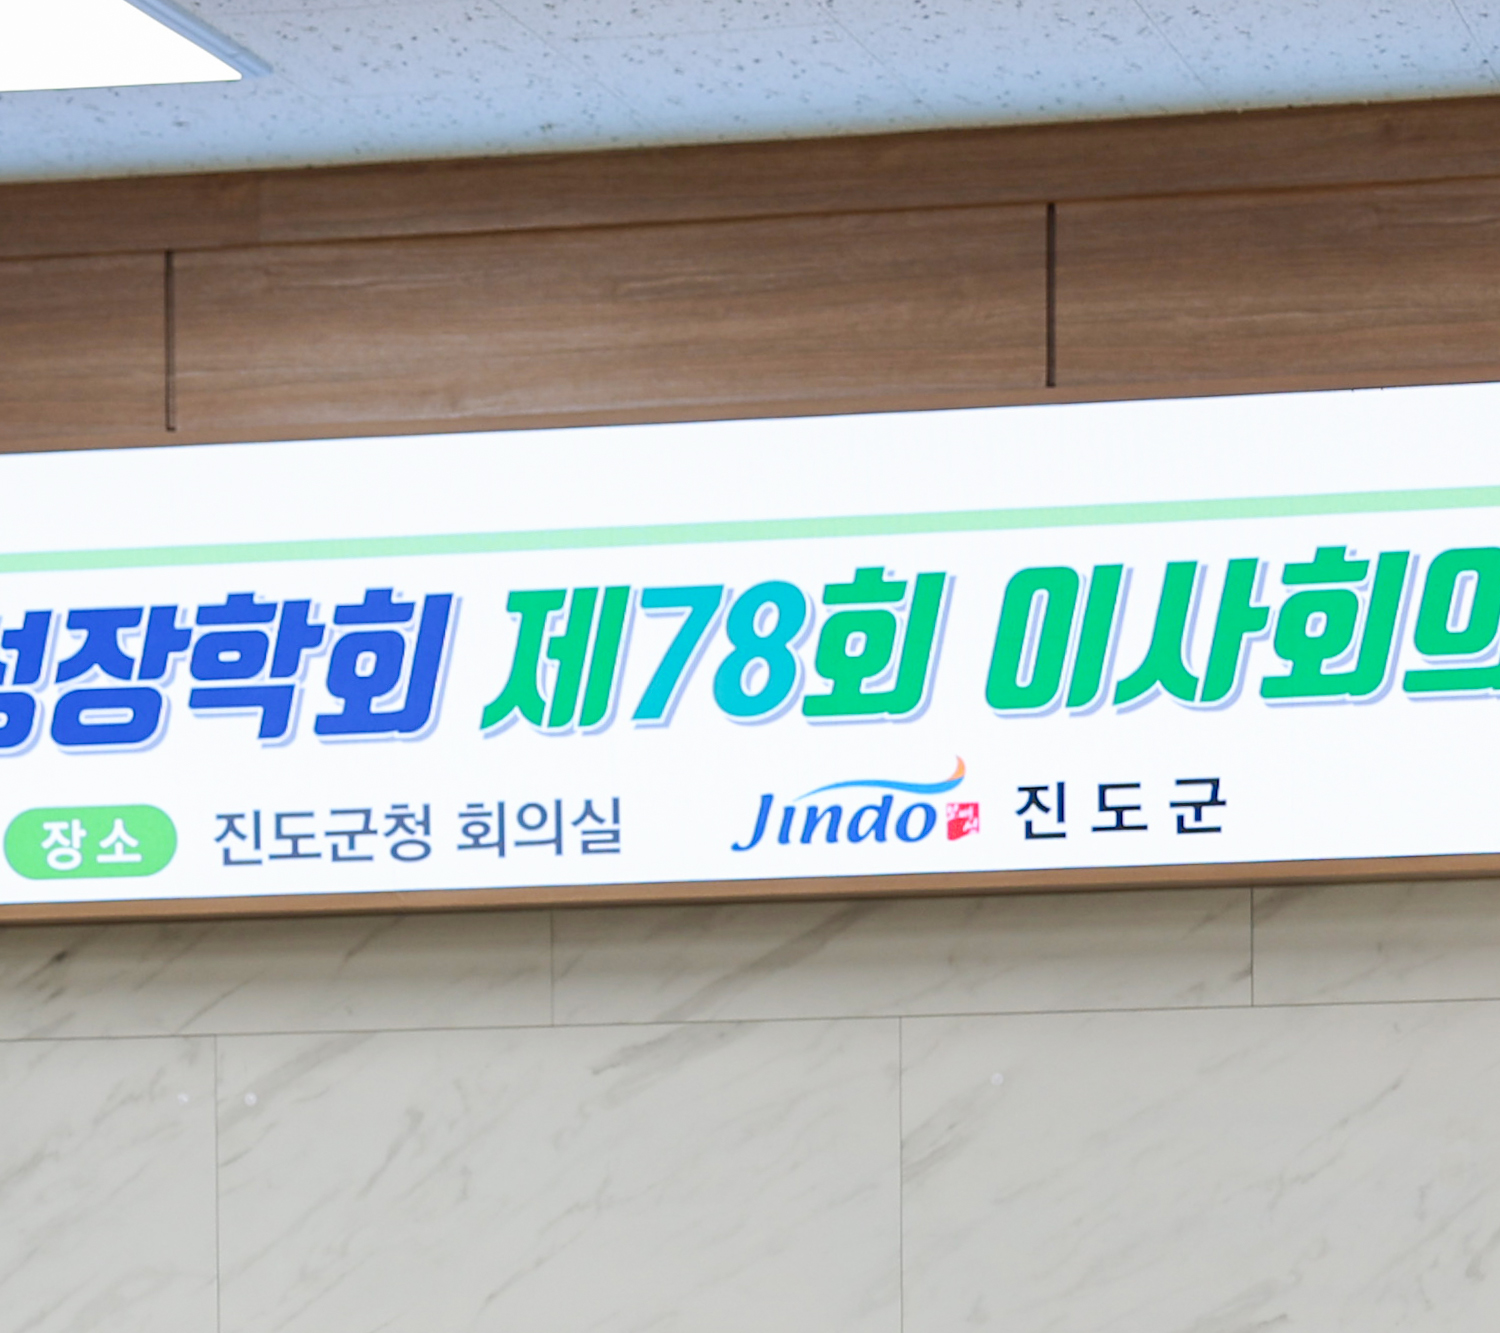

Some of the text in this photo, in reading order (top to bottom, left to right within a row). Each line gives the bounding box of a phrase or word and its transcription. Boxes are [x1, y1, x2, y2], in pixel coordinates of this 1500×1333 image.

[478, 565, 948, 731] 제78회
[42, 796, 621, 869] 장소 진도군청 회의실
[731, 793, 938, 852] Jindo
[1015, 777, 1227, 840] 진도군
